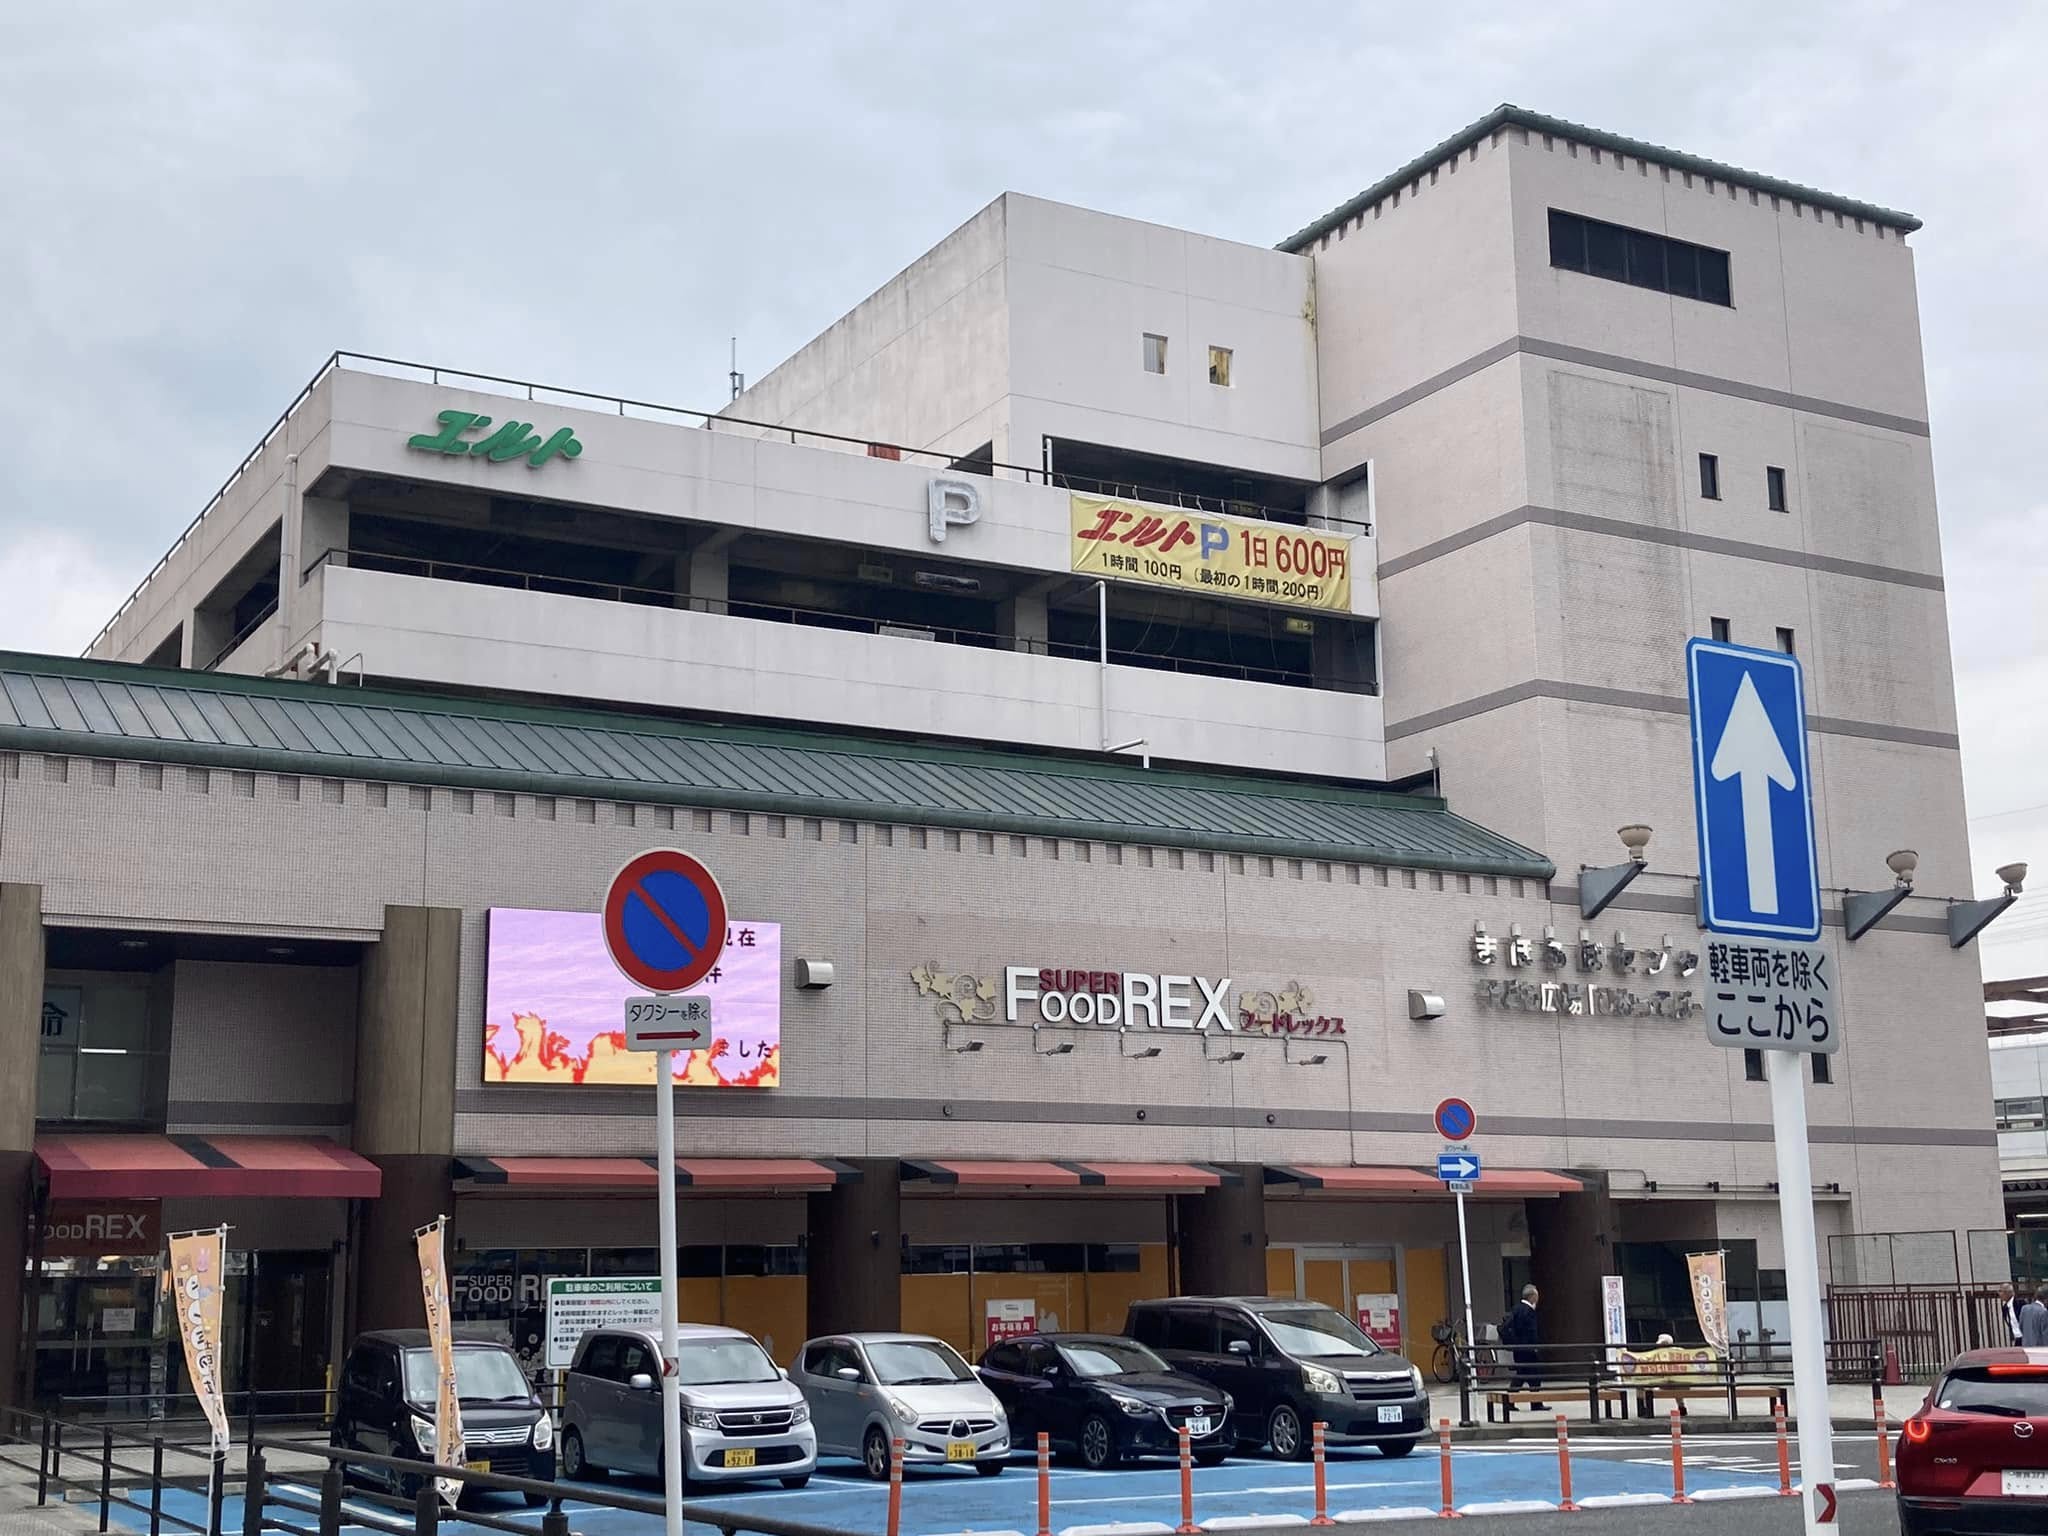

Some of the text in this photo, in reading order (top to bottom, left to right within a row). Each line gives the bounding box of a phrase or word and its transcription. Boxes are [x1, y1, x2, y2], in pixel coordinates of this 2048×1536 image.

[406, 408, 584, 469] エルト
[928, 479, 983, 544] P
[1077, 509, 1196, 552] エルト
[1200, 523, 1230, 561] P
[1275, 535, 1346, 580] 600円
[1102, 552, 1138, 573] 1時間
[1144, 559, 1182, 580] 100円
[726, 927, 756, 947] 在
[1708, 942, 1829, 991] 軽車両を除く
[1039, 968, 1120, 995] SUPER
[629, 1002, 708, 1022] タクシーを除く
[1240, 1011, 1346, 1036] フードレックス
[1717, 993, 1829, 1042] ここから
[469, 1275, 512, 1287] SUPER
[564, 1282, 654, 1293] 駐車場のご利用について
